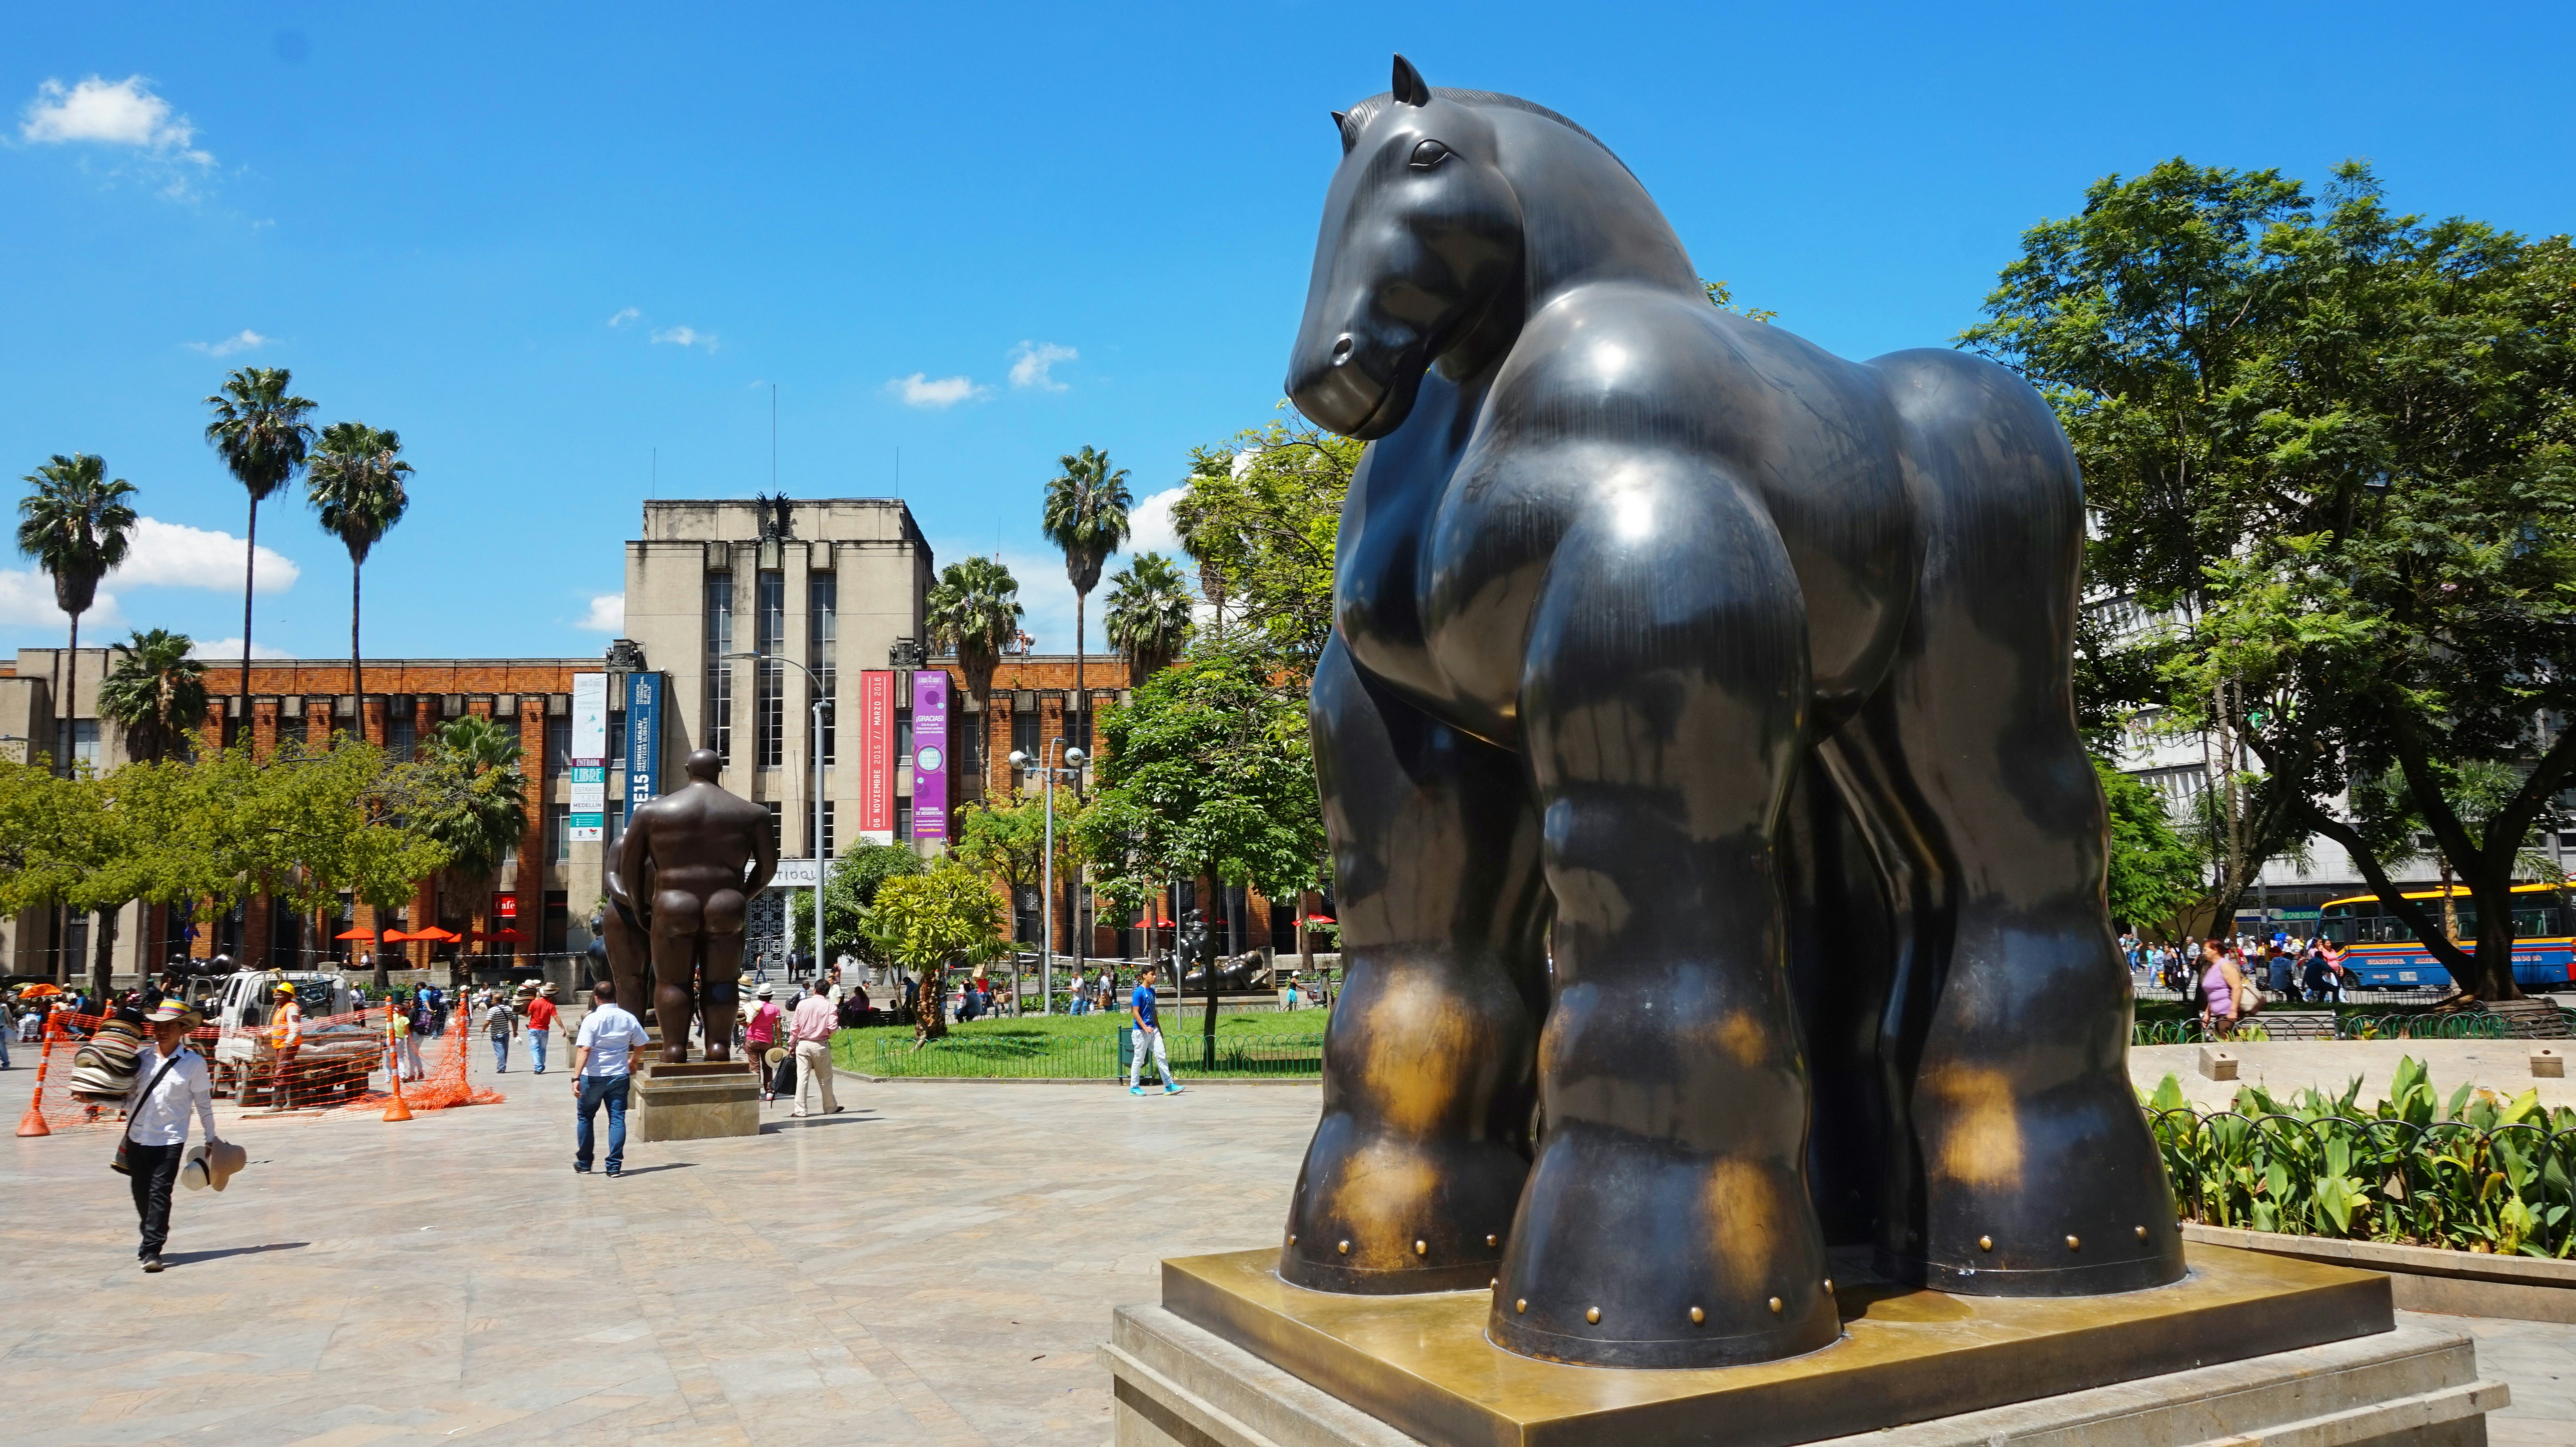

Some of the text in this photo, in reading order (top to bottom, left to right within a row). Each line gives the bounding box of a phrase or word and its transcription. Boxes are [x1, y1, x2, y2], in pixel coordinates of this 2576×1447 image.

[576, 758, 600, 766] ENTRADA
[574, 768, 602, 782] LIBRE
[496, 900, 515, 910] Café
